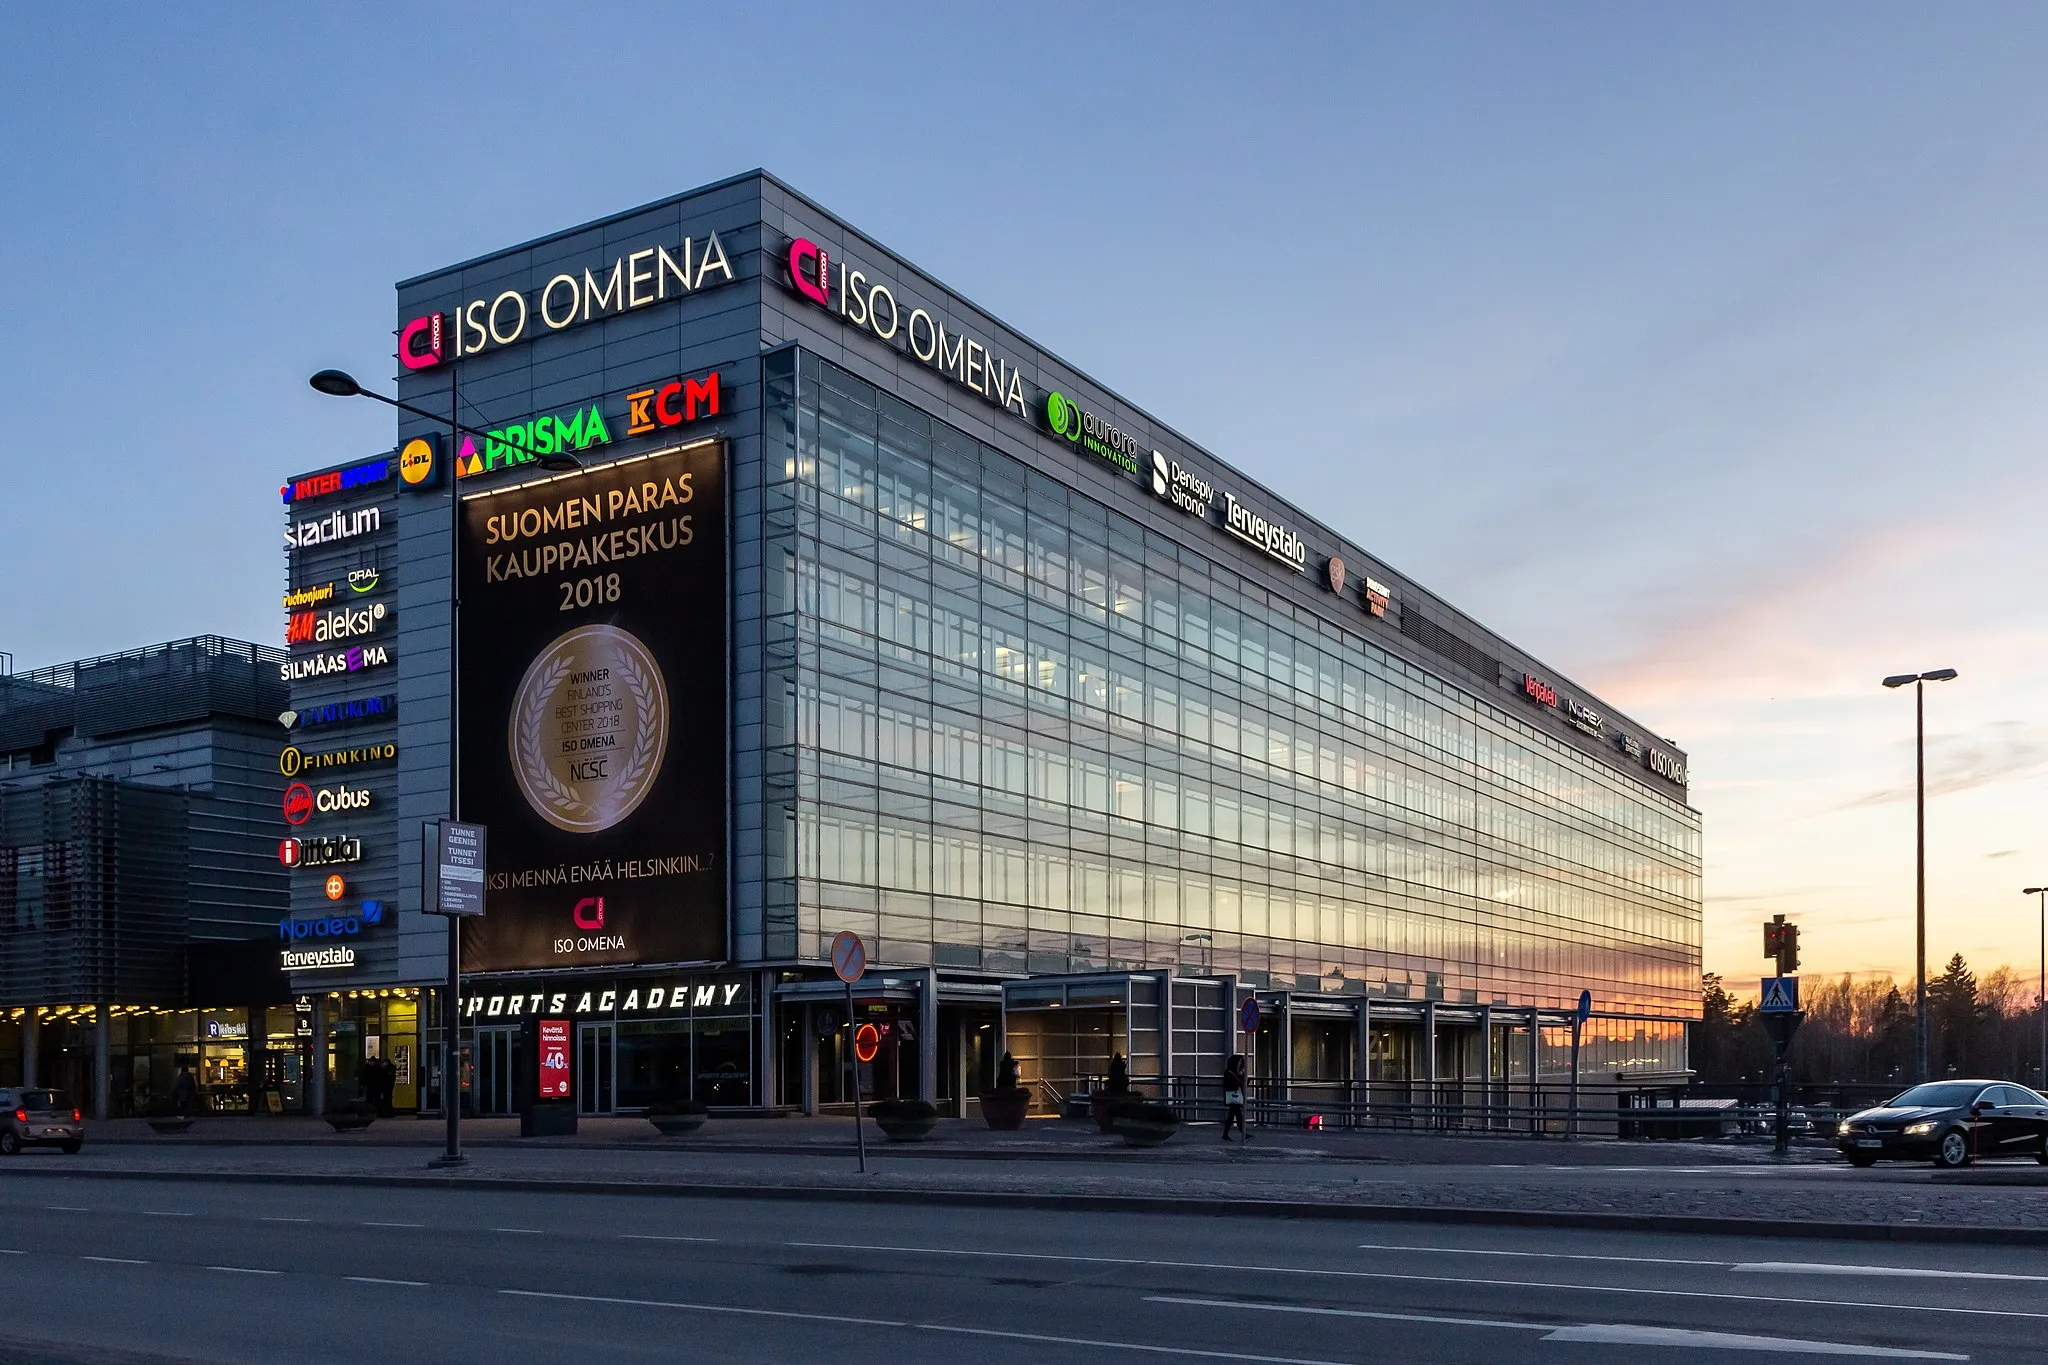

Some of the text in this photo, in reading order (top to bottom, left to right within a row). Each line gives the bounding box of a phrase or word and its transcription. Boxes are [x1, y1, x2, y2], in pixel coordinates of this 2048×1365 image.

[456, 229, 733, 356] ISO OMENA
[433, 314, 441, 350] CITYCON
[841, 262, 1026, 417] ISO OMENA
[485, 404, 611, 469] PRISMA
[1083, 411, 1137, 459] aurora
[1084, 435, 1137, 474] INNOVATION
[1171, 461, 1214, 503] Dentsply
[486, 473, 694, 545] SUOMEN PARAS
[1171, 484, 1205, 518] Sirona
[283, 507, 380, 548] stadium
[1223, 492, 1305, 563] Terveystalo
[486, 515, 694, 583] KAUPPAKESKUS
[348, 567, 379, 582] ORAL
[559, 573, 621, 611] 2018
[280, 646, 388, 681] SILMÄASEMA
[570, 668, 609, 684] WINNER
[567, 684, 611, 700] FINLAND'S
[555, 698, 623, 719] BEST SHOPPING
[561, 715, 620, 734] CENTER 2018
[304, 744, 395, 769] FINNKINO
[562, 735, 615, 752] ISO OMENA
[570, 760, 608, 781] NCSC
[316, 785, 370, 812] Cubus
[448, 836, 477, 846] GEENISI
[450, 827, 475, 838] TUNNE
[448, 847, 477, 858] TUNNET
[451, 856, 474, 866] ITSESI
[484, 872, 508, 891] IKSI
[512, 864, 567, 888] MENNÄ
[571, 860, 613, 883] ENÄÄ
[280, 915, 358, 939] Nordea
[281, 946, 354, 968] Terveystalo
[554, 935, 625, 953] ISO OMENA
[576, 984, 740, 1013] ACADEMY
